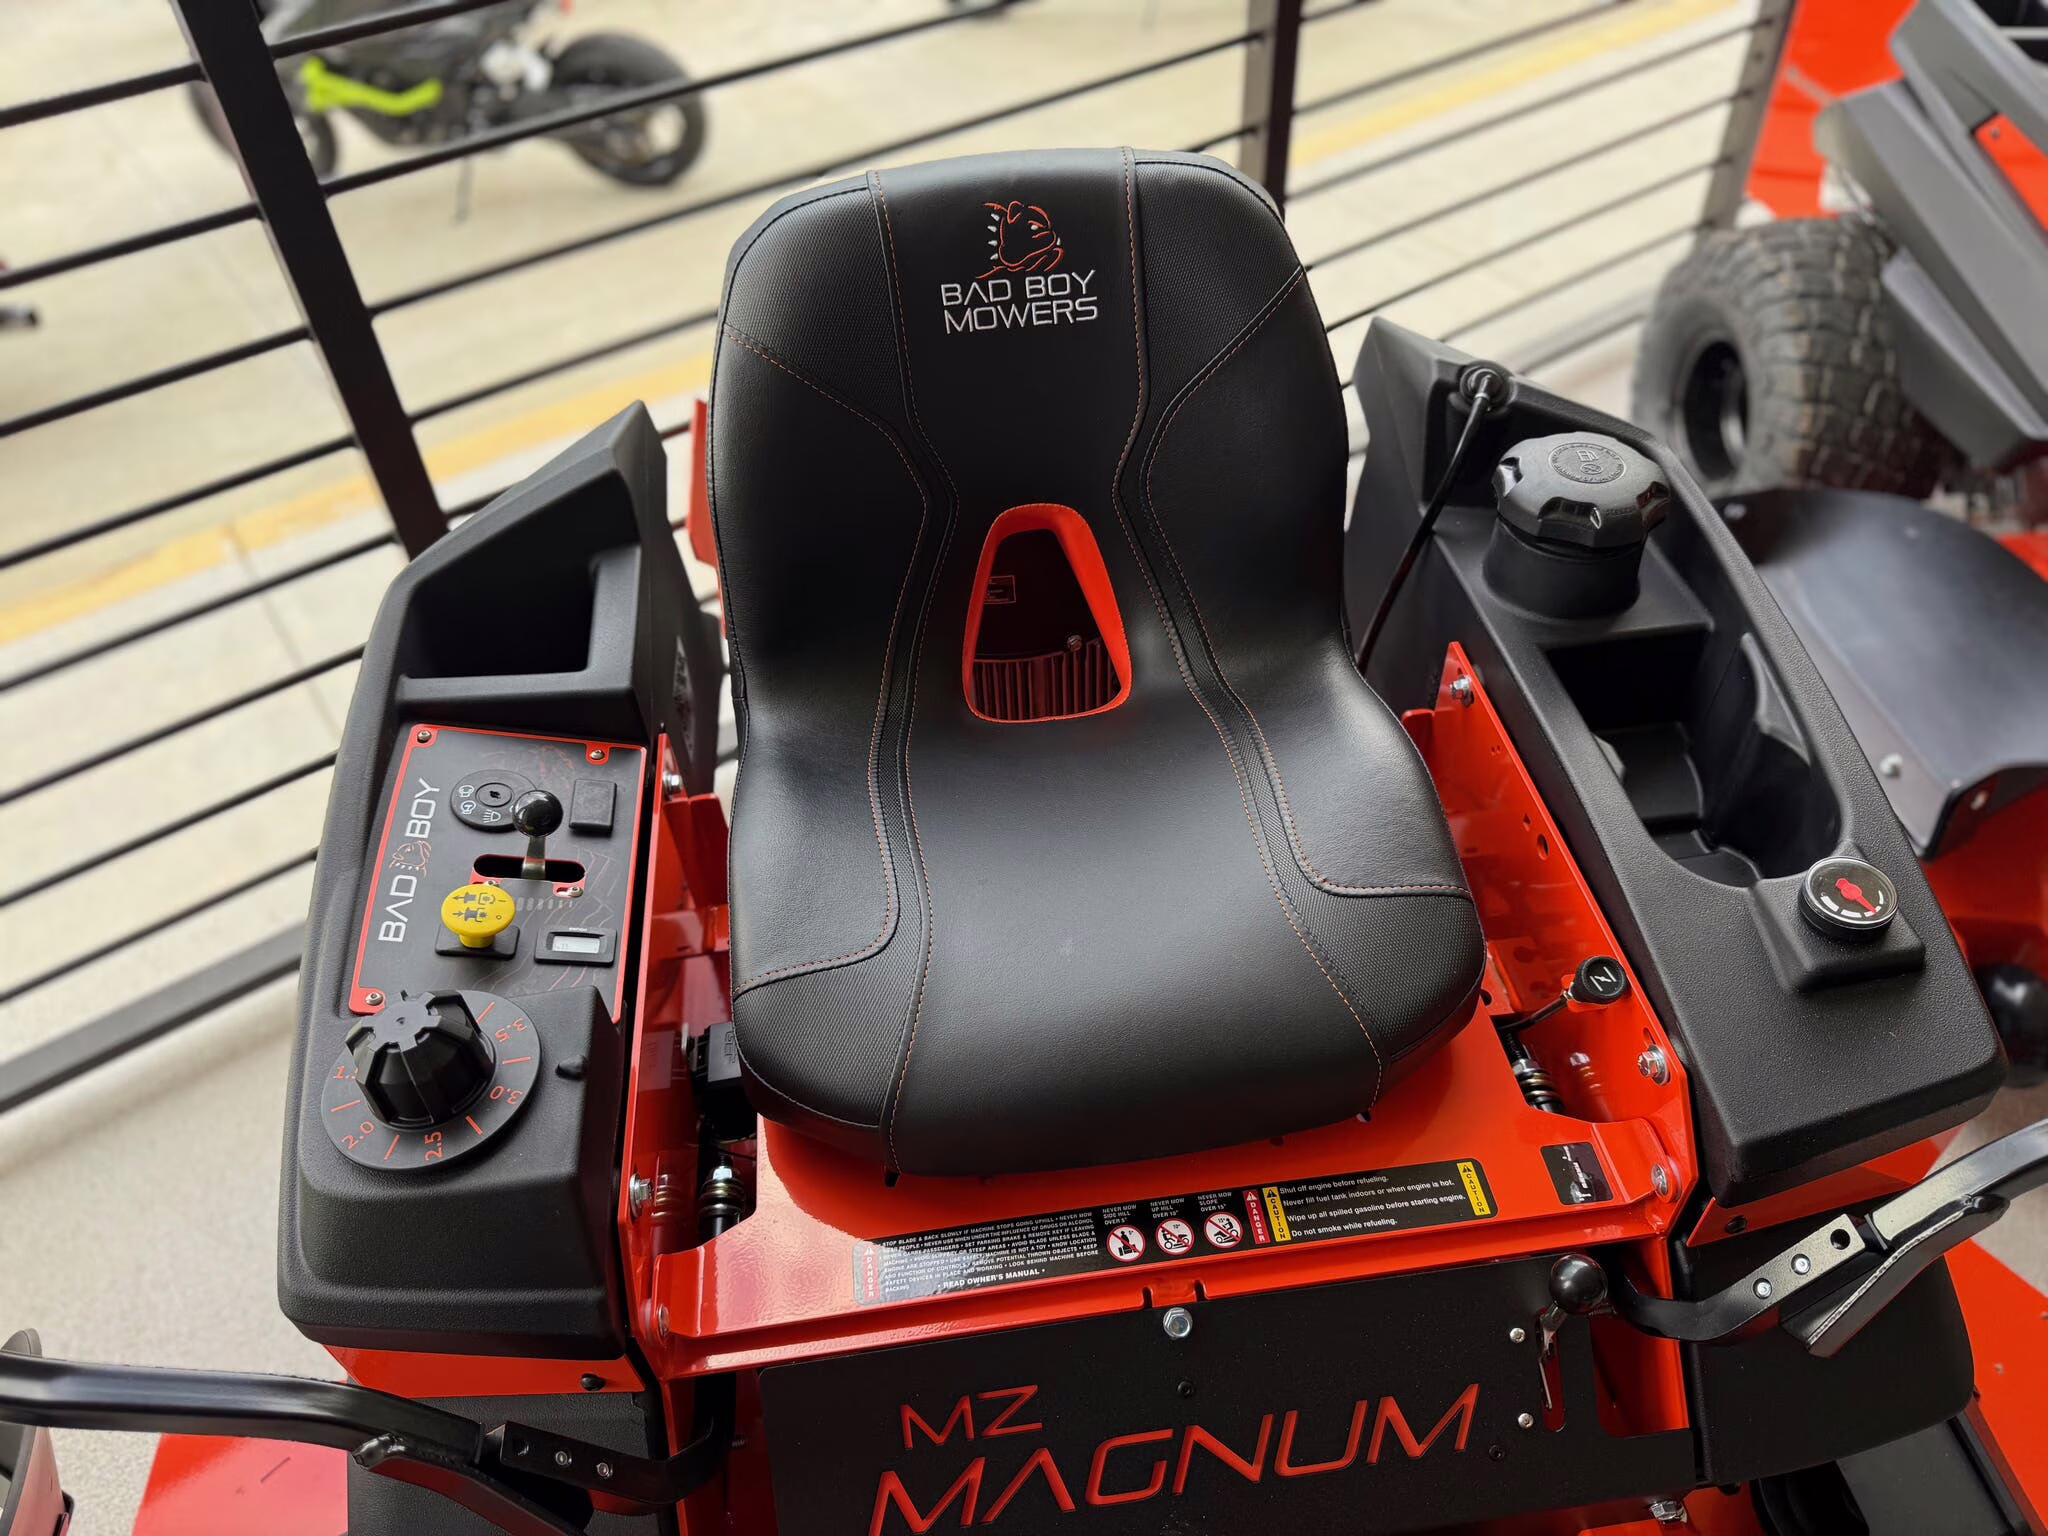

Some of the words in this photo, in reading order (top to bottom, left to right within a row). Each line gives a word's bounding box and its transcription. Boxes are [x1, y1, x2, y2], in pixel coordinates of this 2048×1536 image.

[941, 279, 1012, 306] BAD
[1025, 269, 1096, 298] BOY
[944, 296, 1098, 335] MOWERS
[378, 873, 418, 943] BAD
[406, 777, 441, 839] BOY
[495, 1017, 528, 1043] 3.5
[490, 1085, 523, 1105] 3.0
[341, 1121, 376, 1149] 2.0
[424, 1132, 444, 1161] 2.5
[1279, 1186, 1296, 1194] Shut
[1308, 1182, 1332, 1192] engine
[1332, 1179, 1355, 1187] before
[1356, 1174, 1389, 1185] refueling.
[1283, 1198, 1304, 1207] Never
[1316, 1195, 1330, 1203] fuel
[1331, 1193, 1347, 1201] tank
[1348, 1189, 1375, 1199] indoors
[1386, 1185, 1406, 1194] when
[1406, 1182, 1431, 1192] engine
[1440, 1178, 1455, 1187] hot.
[1466, 1173, 1485, 1213] CAUTION
[1250, 1202, 1265, 1241] DANGER
[1270, 1198, 1286, 1239] CAUTION
[1287, 1214, 1306, 1223] Wipe
[1329, 1208, 1353, 1218] spilled
[1354, 1204, 1385, 1214] gasoline
[1385, 1200, 1409, 1209] before
[1410, 1196, 1439, 1207] starting
[1439, 1193, 1466, 1203] engine.
[923, 1244, 959, 1254] PASSENGERS
[977, 1238, 1001, 1246] PARKING
[1071, 1224, 1095, 1232] LEAVING
[971, 1226, 995, 1234] MACHINE
[1001, 1227, 1030, 1236] INFLUENCE
[1068, 1218, 1094, 1226] ALCOHOL
[1049, 1234, 1070, 1242] UNLESS
[1317, 1224, 1341, 1233] smoke
[1343, 1222, 1362, 1230] while
[1363, 1217, 1398, 1229] refueling.
[898, 1269, 925, 1278] FUNCTION
[996, 1253, 1026, 1263] POTENTIAL
[1028, 1250, 1051, 1258] THROWN
[1052, 1245, 1077, 1254] OBJECTS
[1083, 1242, 1098, 1250] KEEP
[985, 1250, 1009, 1258] MACHINE
[1069, 1236, 1097, 1245] LOCATION
[909, 1275, 933, 1283] DEVICES
[976, 1264, 1003, 1273] WORKING
[1027, 1257, 1048, 1265] BEHIND
[1050, 1253, 1074, 1262] MACHINE
[1076, 1250, 1098, 1258] BEFORE
[943, 1277, 965, 1288] READ
[967, 1273, 1003, 1284] OWNER'S
[1005, 1269, 1040, 1279] MANUAL
[899, 1384, 1044, 1450] MZ
[868, 1383, 1480, 1536] MAGNUM
